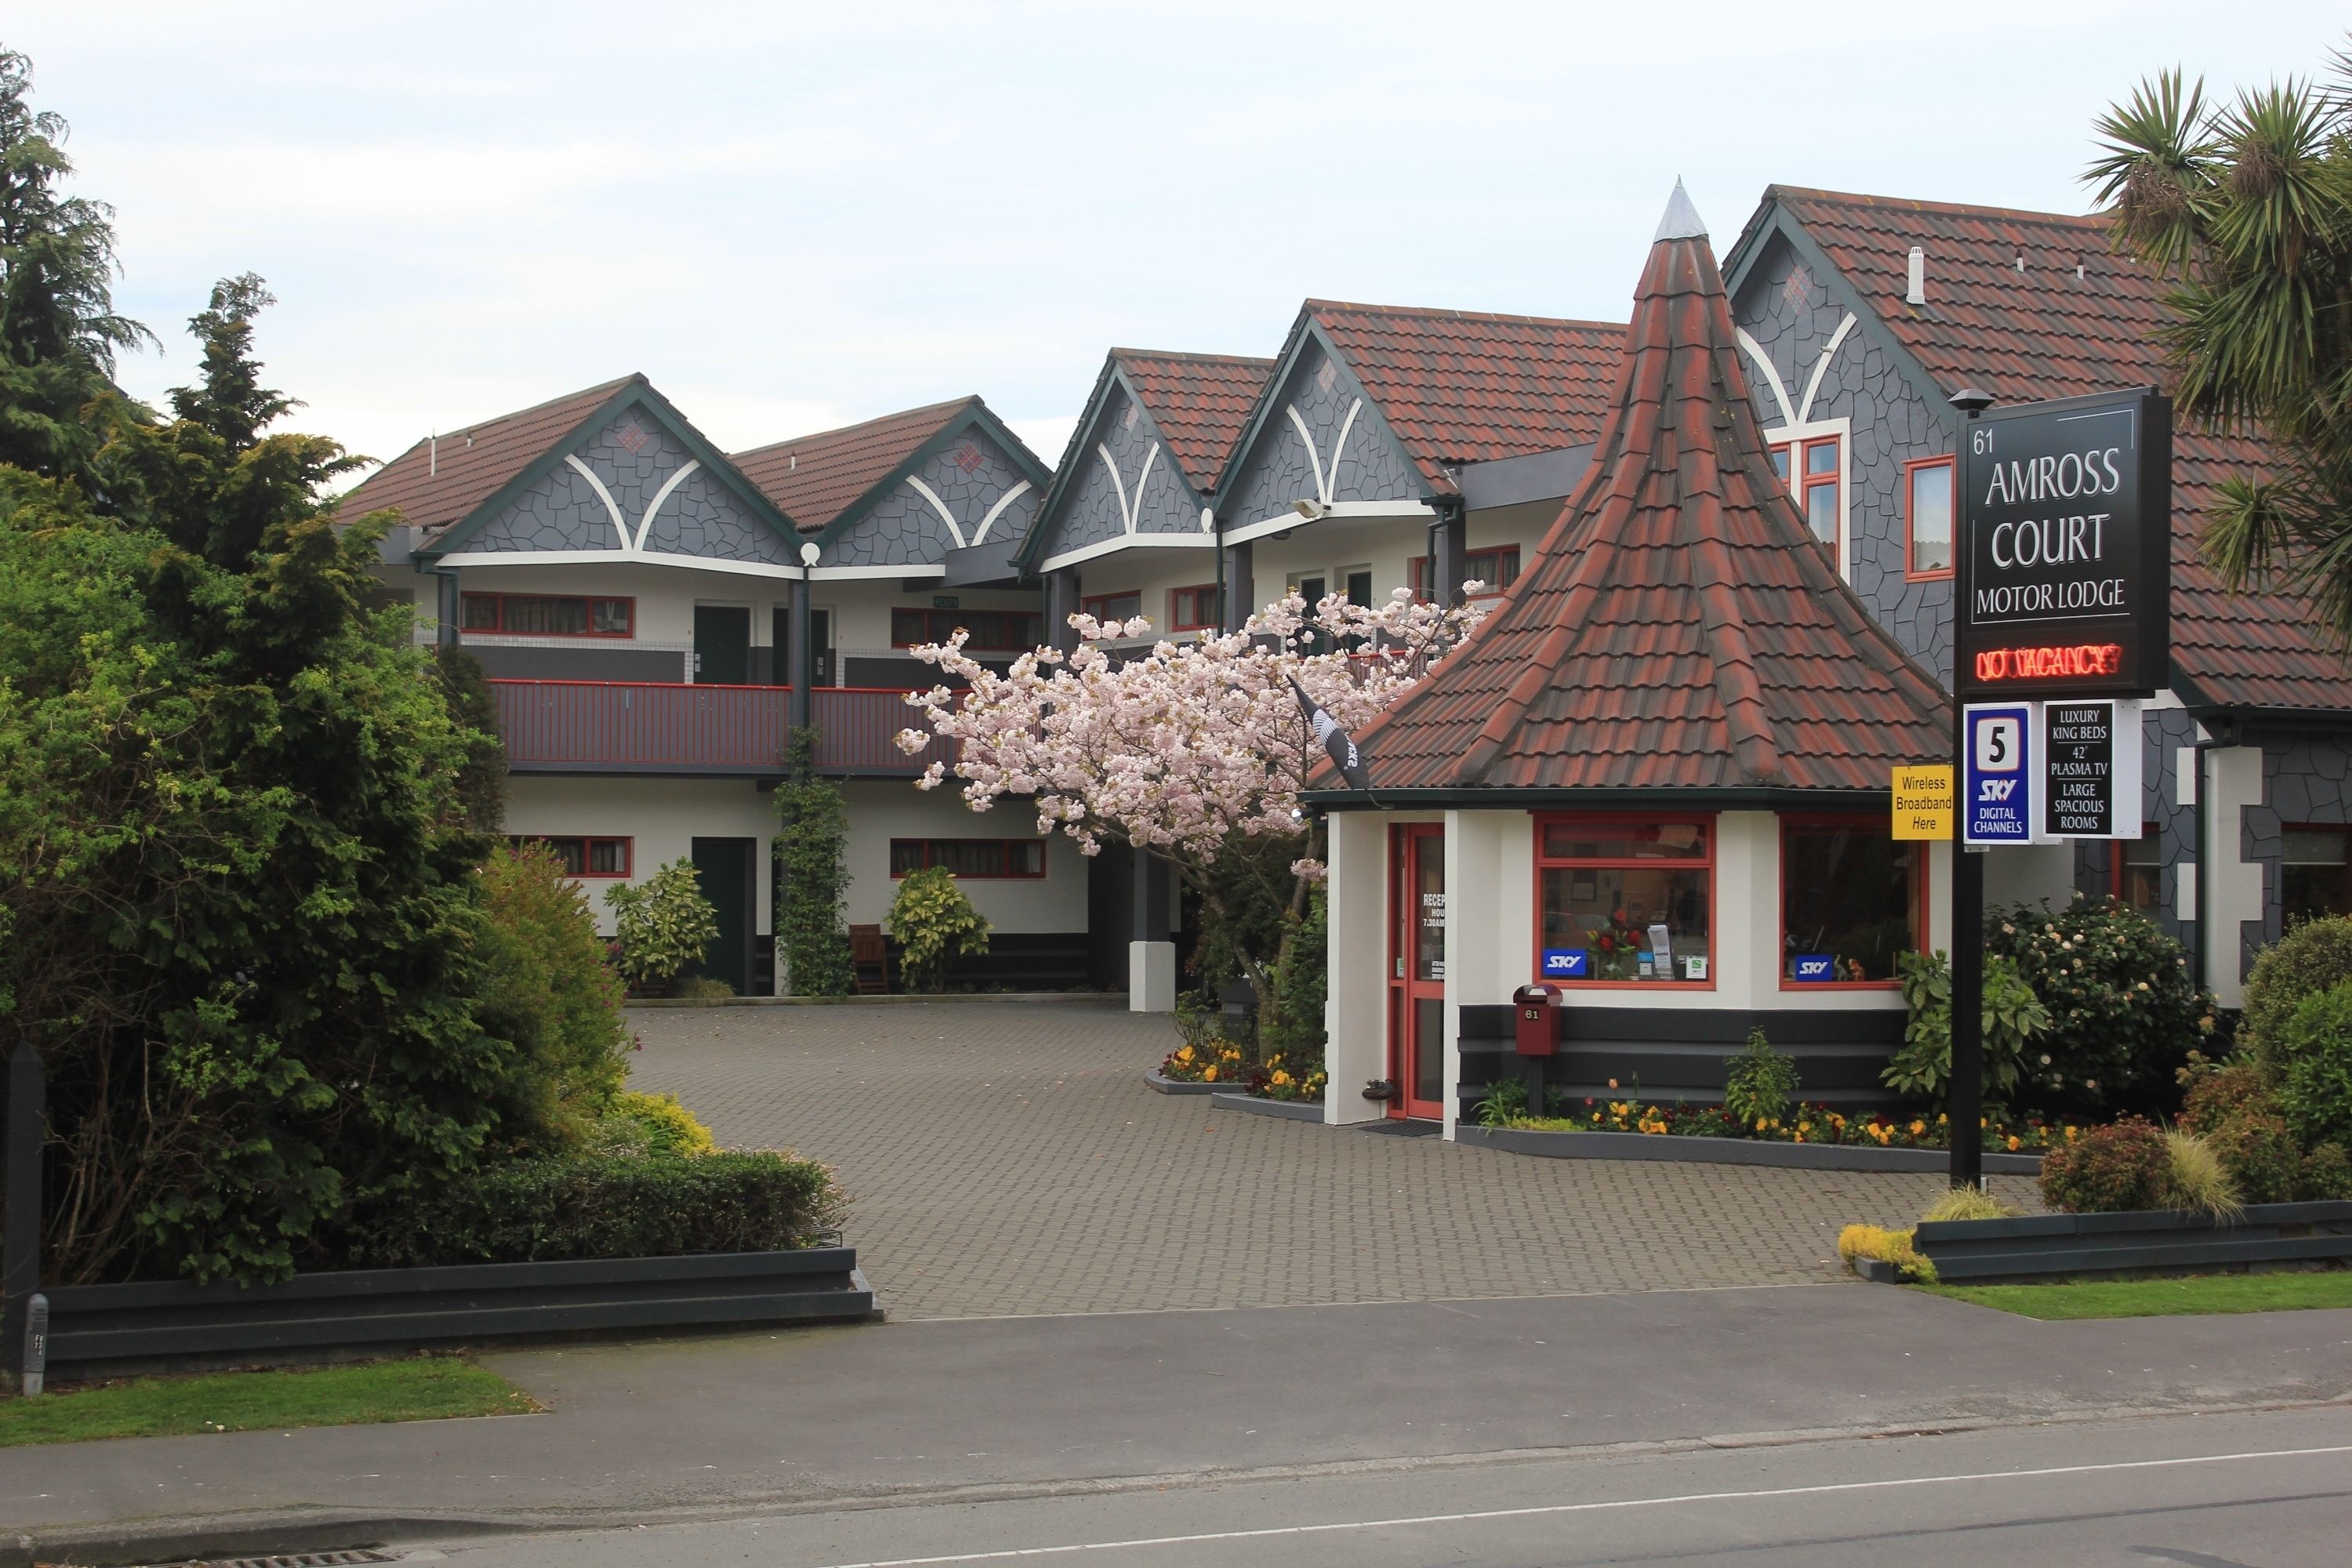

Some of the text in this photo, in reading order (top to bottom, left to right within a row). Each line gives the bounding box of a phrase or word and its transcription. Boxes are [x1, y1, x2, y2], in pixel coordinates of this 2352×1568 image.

[1973, 428, 1993, 456] 61
[1985, 448, 2120, 507] AMROSS
[1991, 514, 2111, 569] COURT
[1976, 579, 2125, 614] MOTOR LODGE
[2015, 646, 2108, 677] VACANCY
[2060, 710, 2100, 723] LUXURY
[2053, 726, 2107, 739] KING BEDS
[1989, 726, 2005, 763] 5
[2051, 762, 2108, 775] PLASMA TV
[1902, 775, 1945, 789] Wireless
[1978, 779, 2017, 800] SKY
[2063, 783, 2096, 796] LARGE
[1896, 795, 1952, 810] Broadband
[2054, 800, 2104, 813] SPACIOUS
[1980, 807, 2016, 819] DIGITAL
[1912, 816, 1936, 829] Here
[1974, 821, 2023, 833] CHANNELS
[2060, 816, 2098, 829] ROOMS
[1547, 956, 1581, 968] SKY
[1798, 961, 1828, 975] SKY
